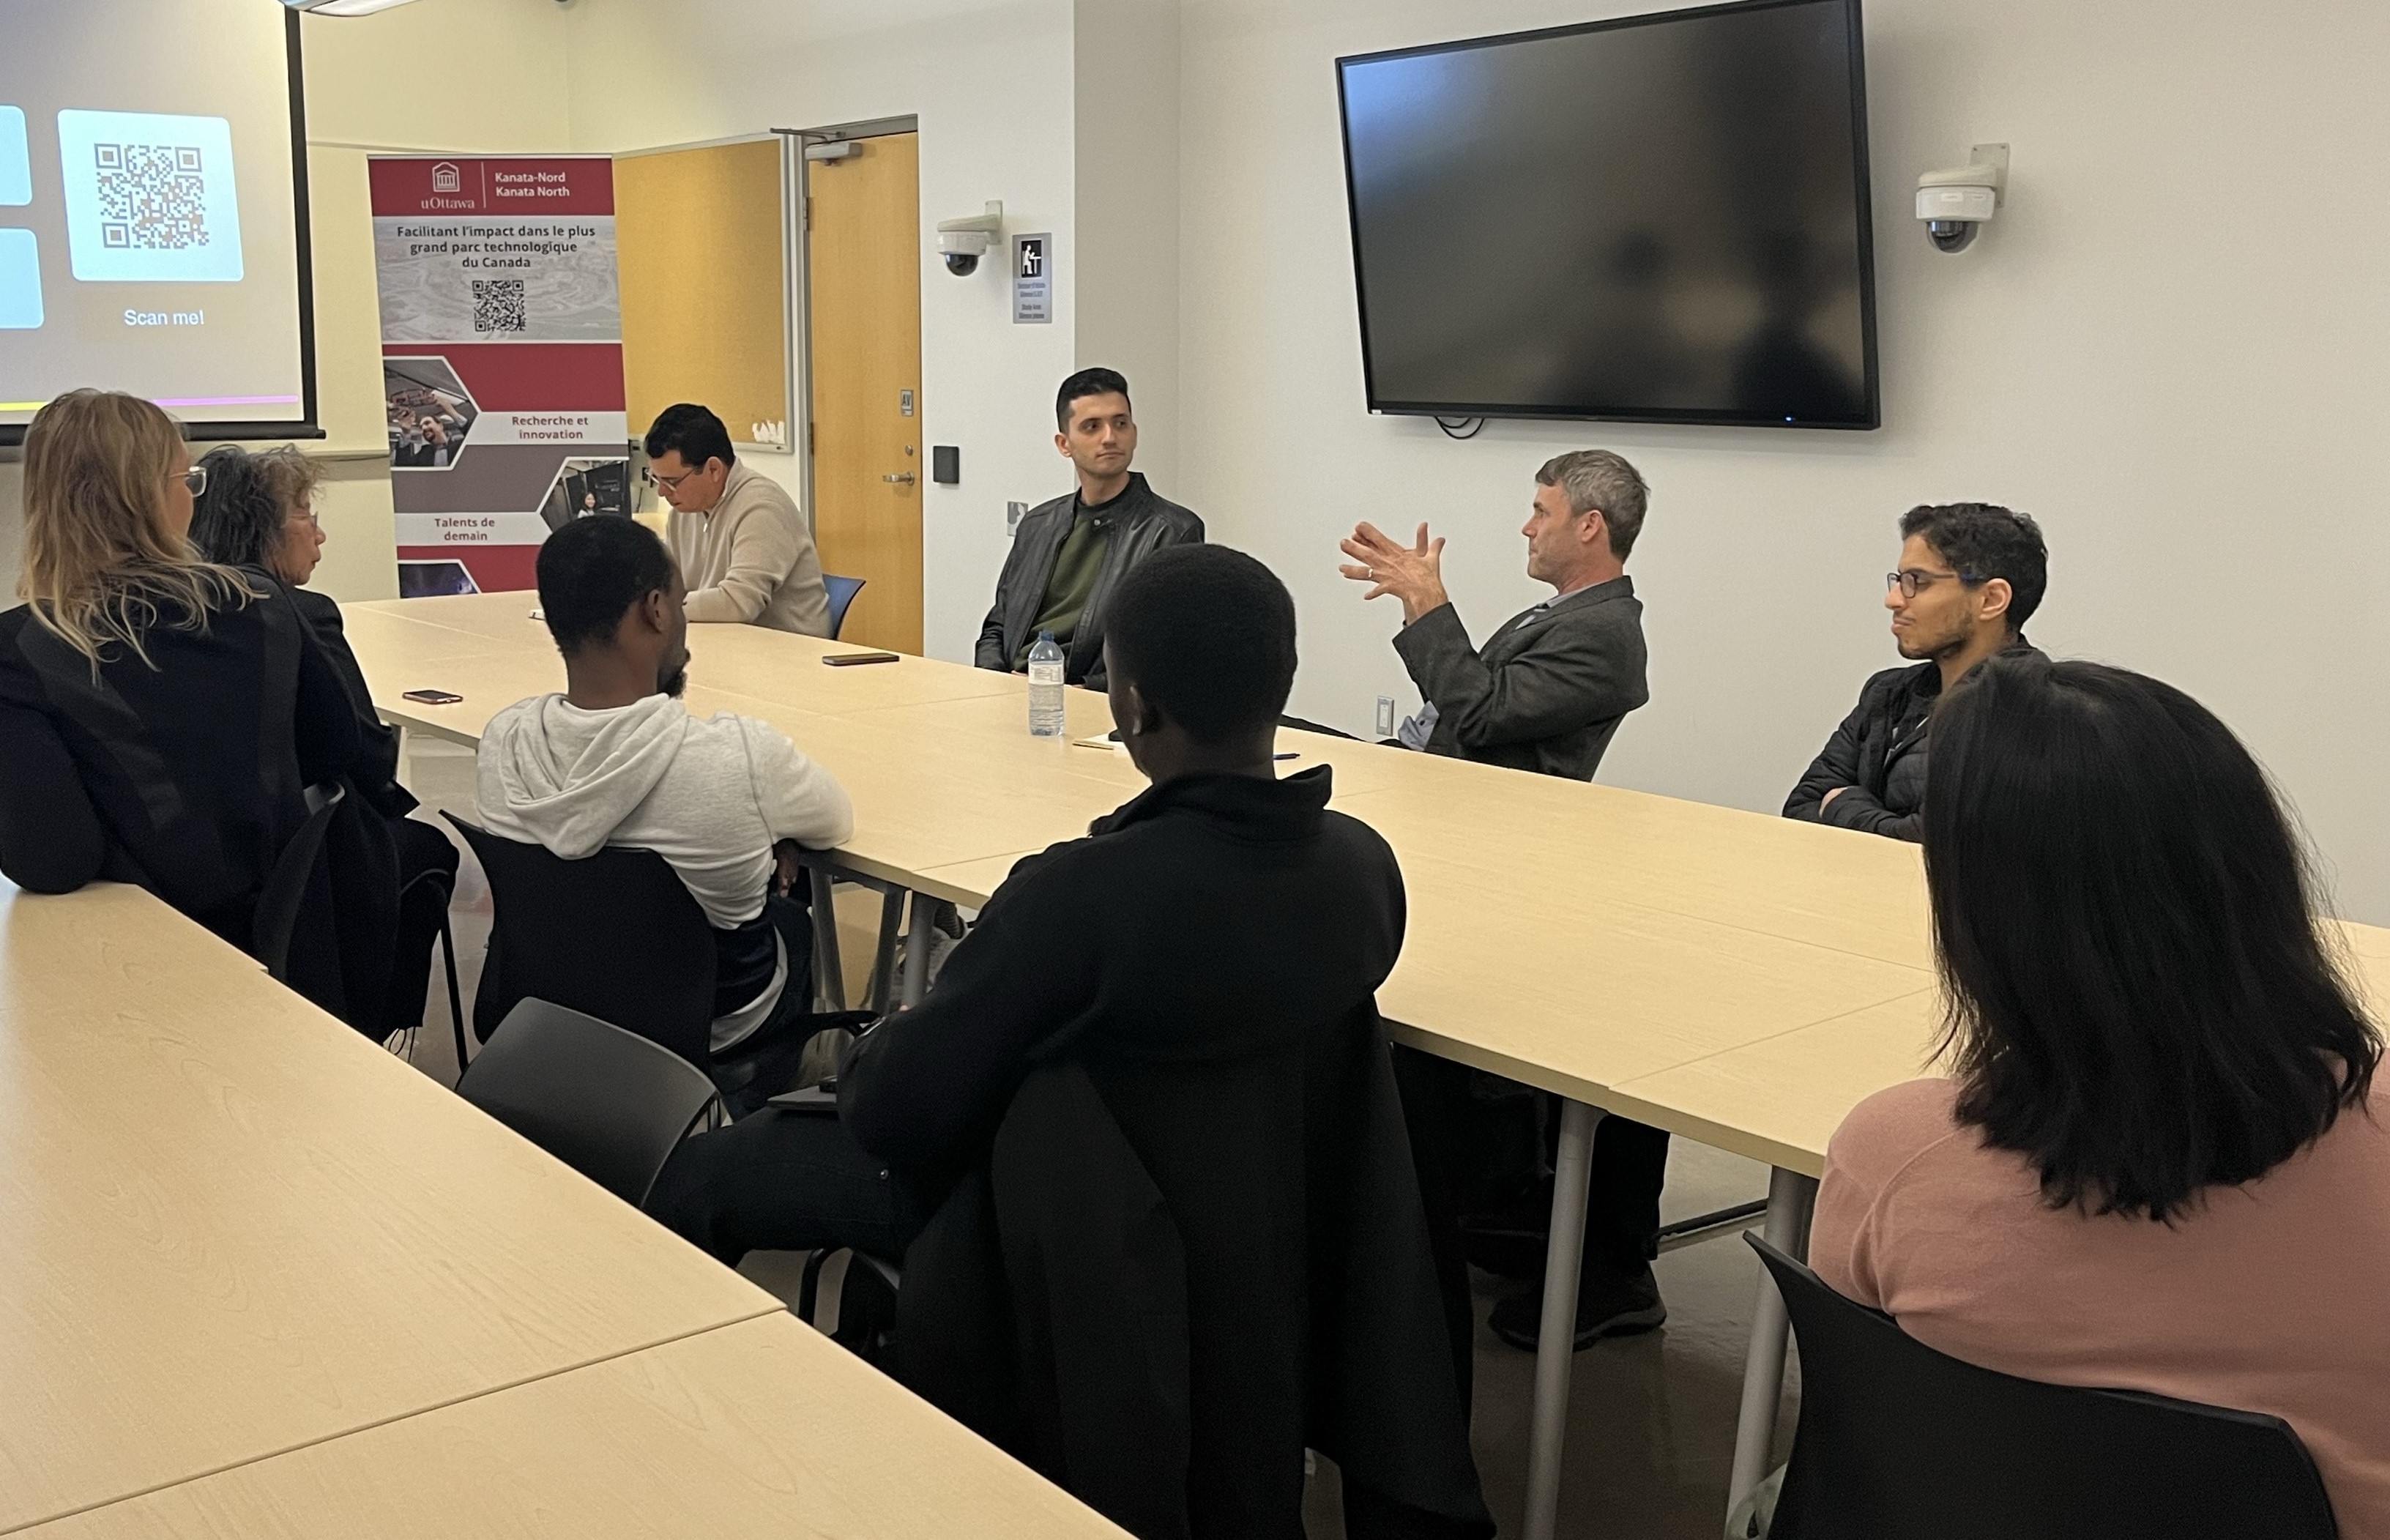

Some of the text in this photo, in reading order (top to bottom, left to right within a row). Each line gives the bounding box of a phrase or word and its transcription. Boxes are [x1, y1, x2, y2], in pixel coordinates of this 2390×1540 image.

[495, 171, 566, 183] Kanata-Nord
[496, 186, 570, 197] Kanata North
[420, 197, 475, 209] uOttawa
[397, 226, 596, 239] Facilitant l'impact dans le plus
[410, 242, 578, 256] grand parc technologique
[462, 257, 531, 268] du Canada
[124, 309, 205, 326] Scan me!
[512, 416, 589, 426] Recherche et
[518, 429, 584, 439] innovation
[434, 518, 495, 527] Talents de
[444, 530, 488, 541] demain
